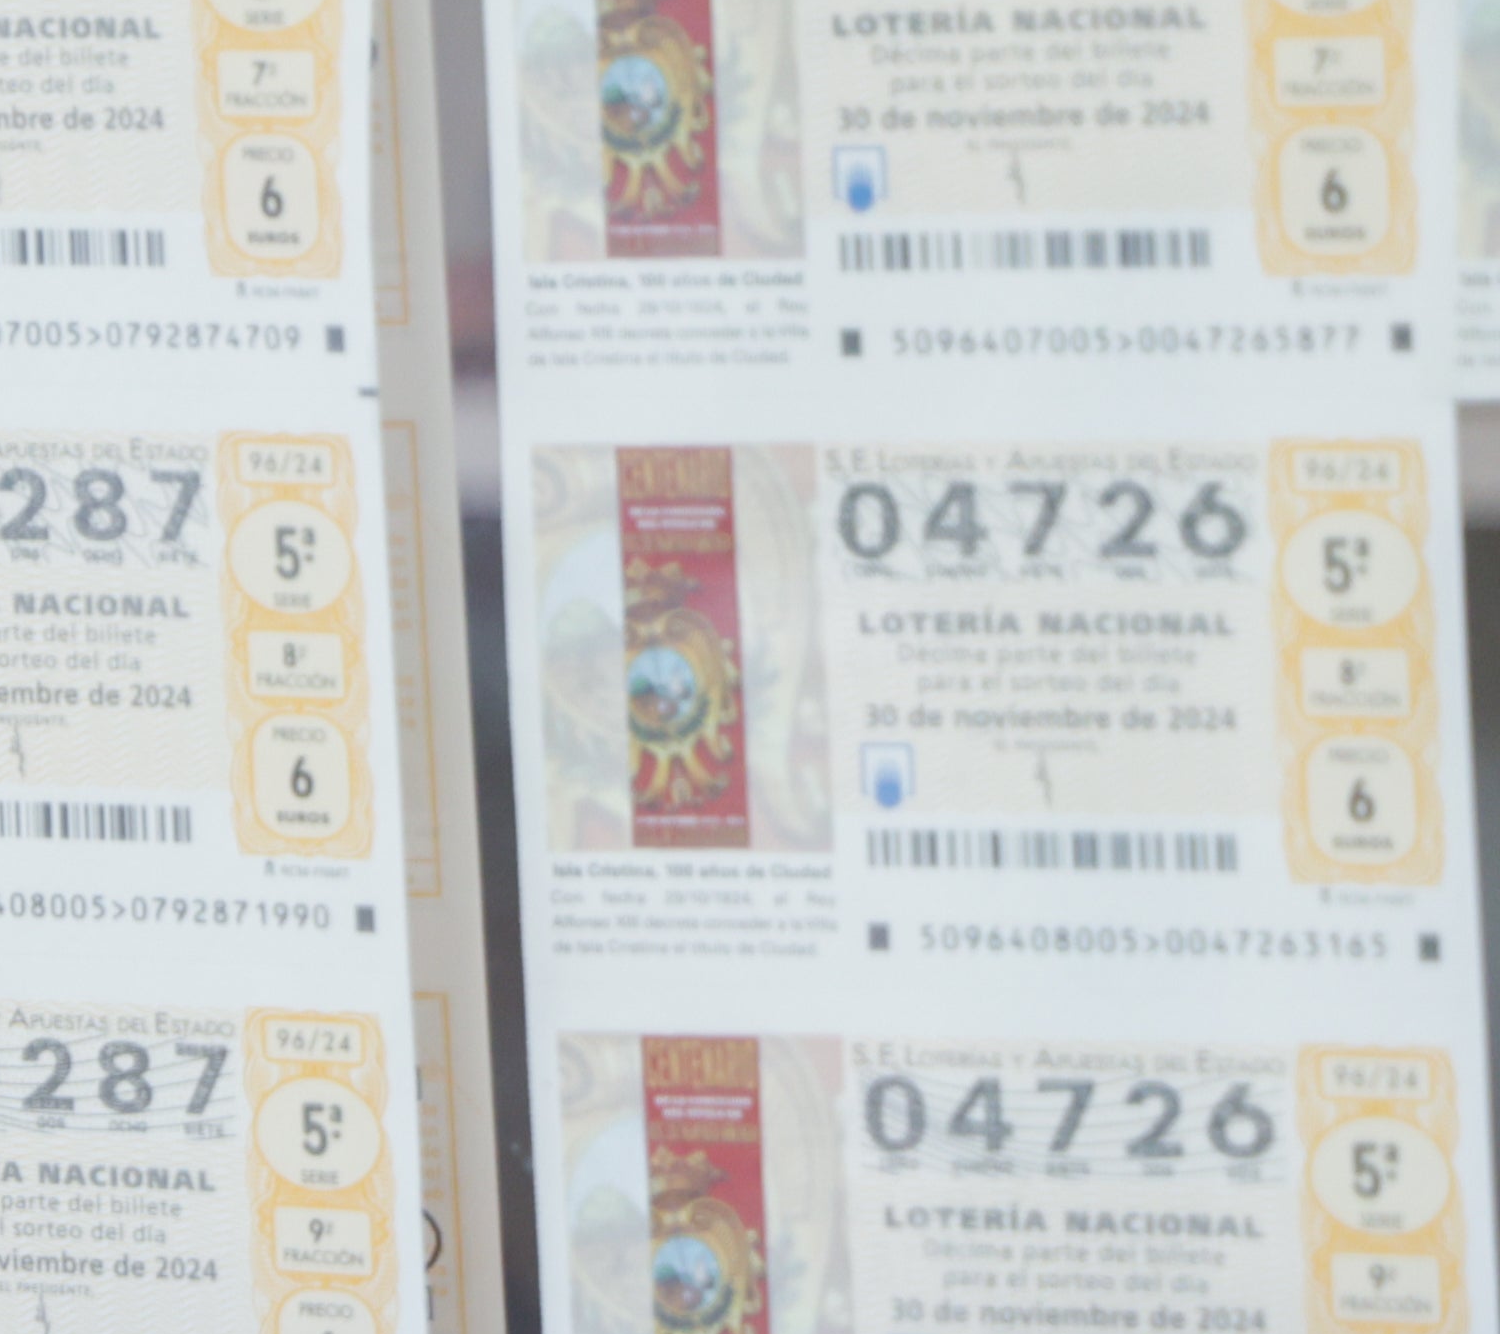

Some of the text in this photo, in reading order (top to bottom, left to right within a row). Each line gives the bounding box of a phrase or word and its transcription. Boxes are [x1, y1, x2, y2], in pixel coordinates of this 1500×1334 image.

[831, 7, 1205, 37] LOTERÍA NACIONAL
[838, 483, 1246, 558] 04726
[13, 593, 190, 618] NACIONAL
[858, 612, 1232, 636] LOTERÍA NACIONAL
[865, 1078, 1273, 1157] 04726
[38, 1163, 215, 1192] NACIONAL
[883, 1206, 1262, 1238] LOTERÍA NACIONAL
[113, 1254, 145, 1278] de
[156, 1256, 218, 1281] 2024
